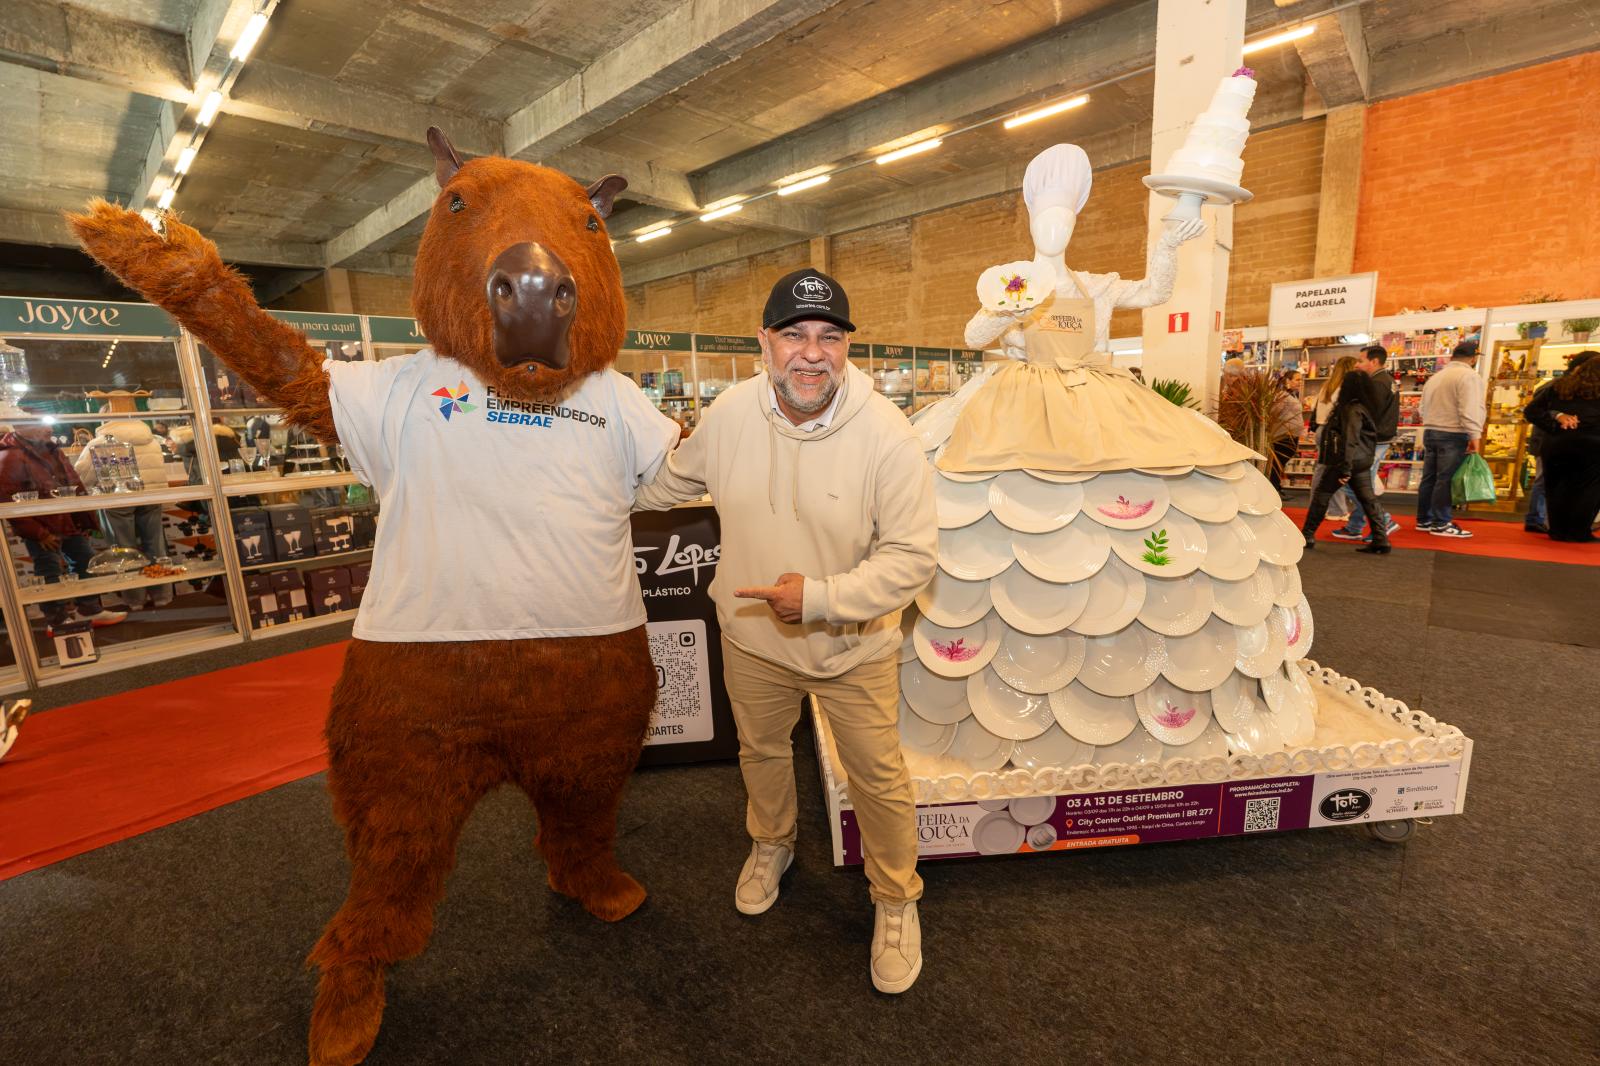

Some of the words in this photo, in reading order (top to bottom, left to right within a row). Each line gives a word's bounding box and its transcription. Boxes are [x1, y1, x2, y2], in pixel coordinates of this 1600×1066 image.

[1296, 286, 1347, 298] PAPELARIA
[1295, 297, 1346, 309] AQUARELA
[18, 301, 120, 330] Joyee
[302, 322, 329, 330] mora
[635, 331, 671, 348] Joyee
[486, 398, 607, 429] EMPREENDEDOR
[486, 411, 554, 428] SEBRAE
[643, 587, 691, 597] PLÁSTICO
[1067, 799, 1081, 808] 03
[1084, 798, 1091, 806] A
[1094, 796, 1105, 806] 13
[1108, 795, 1123, 805] DE
[1125, 789, 1184, 804] SETEMBRO
[960, 816, 970, 824] DA
[1077, 818, 1093, 827] City
[1094, 816, 1121, 825] Center
[1122, 813, 1146, 823] Outlet
[1147, 811, 1180, 820] Premium
[1186, 809, 1197, 817] BR
[1199, 807, 1213, 816] 277
[1066, 840, 1097, 848] ENTRADA
